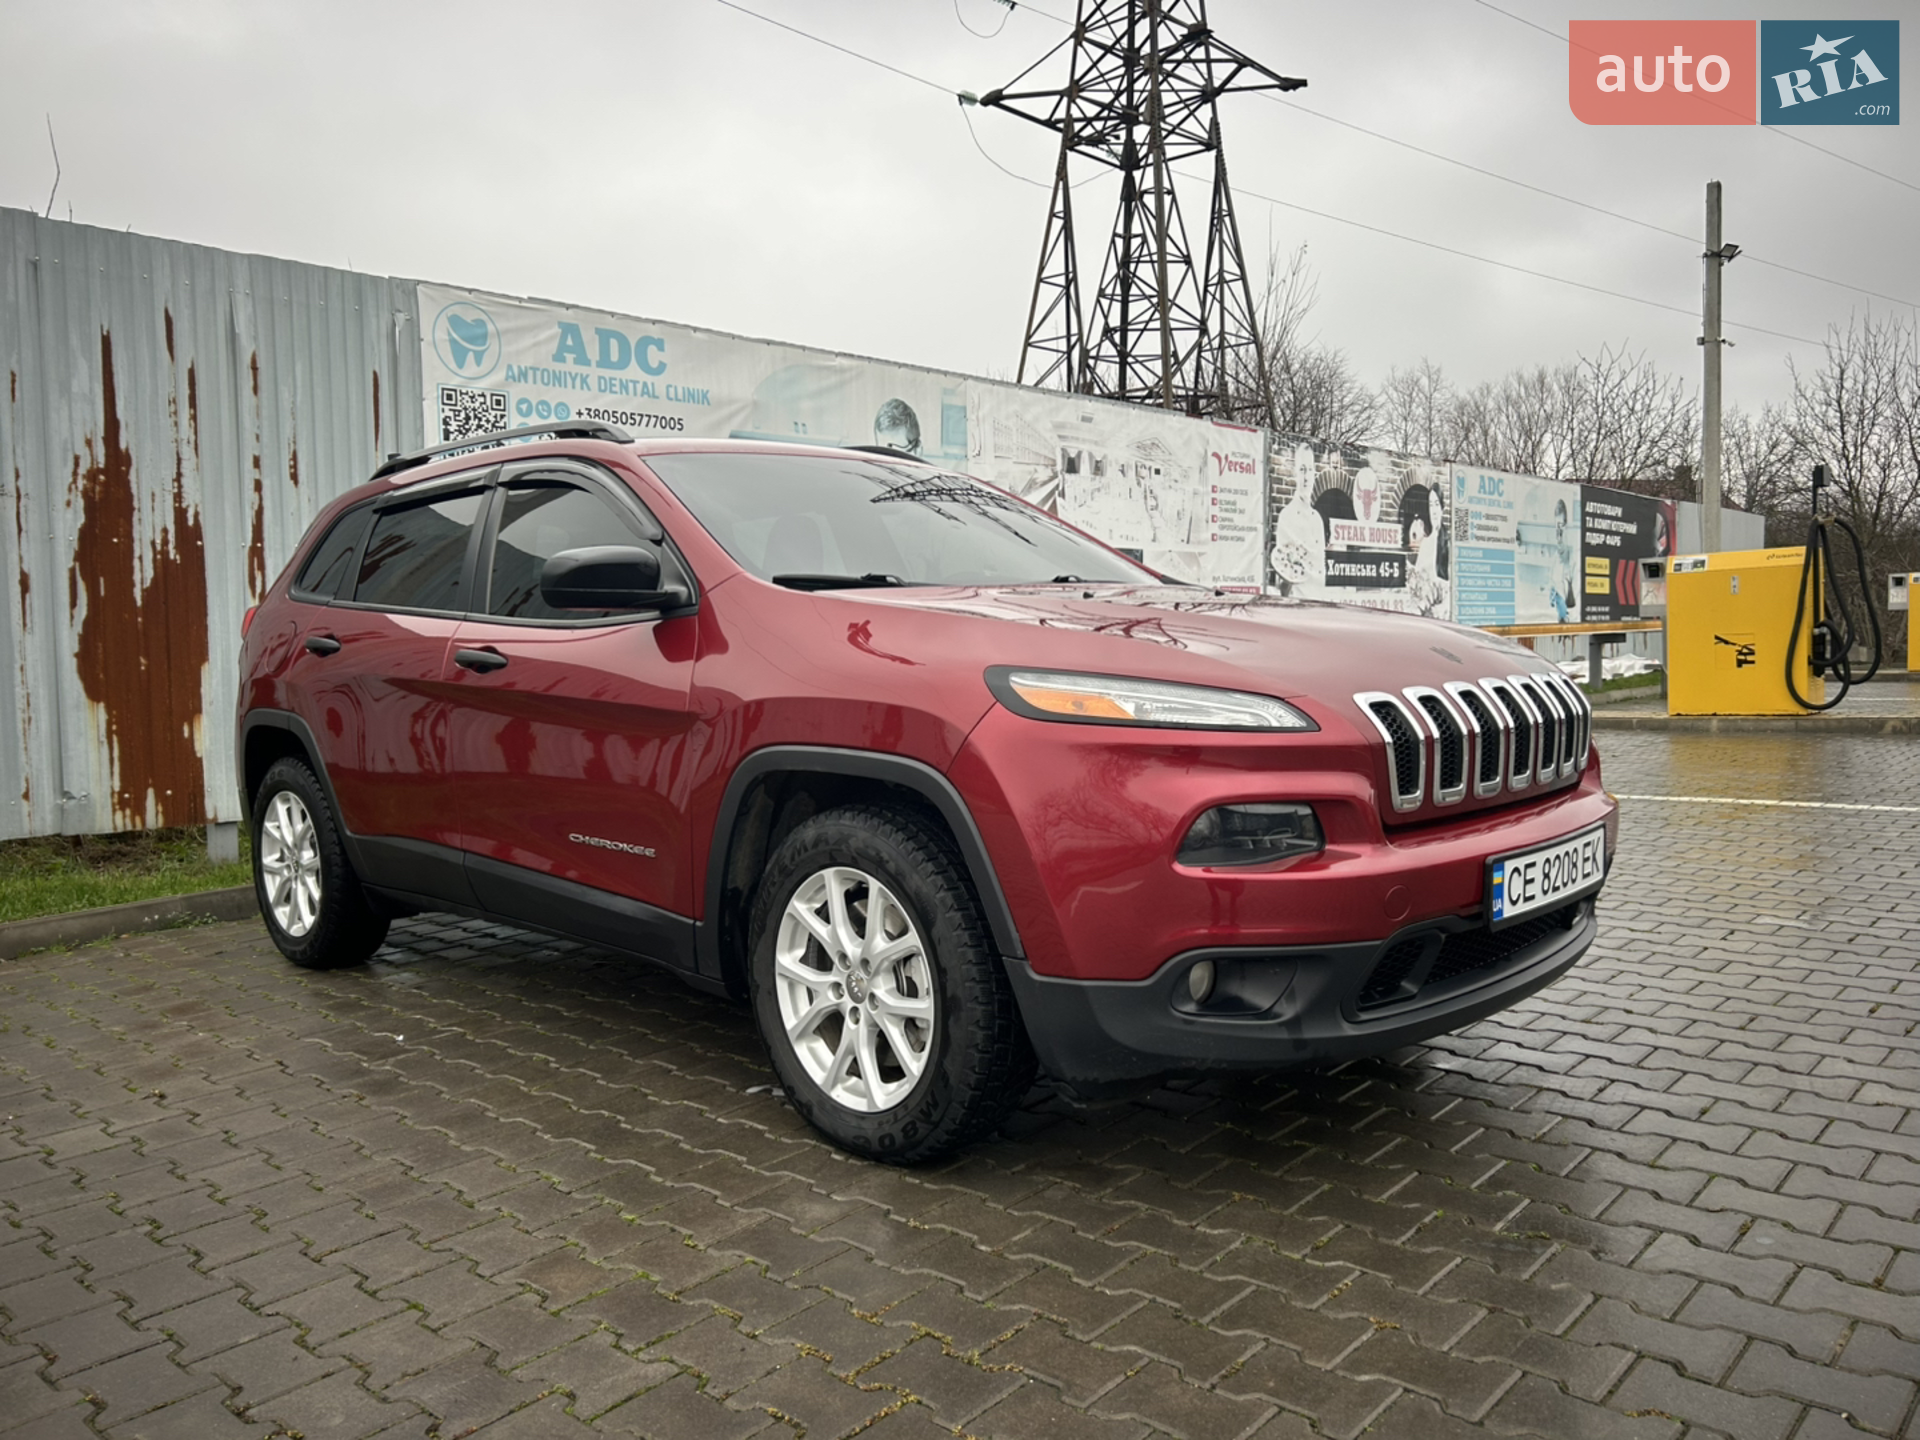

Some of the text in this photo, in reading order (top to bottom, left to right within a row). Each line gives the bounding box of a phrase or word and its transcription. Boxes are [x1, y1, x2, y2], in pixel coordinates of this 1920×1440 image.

[552, 321, 668, 377] ADC
[505, 364, 712, 406] ANTONIYK DENTAL CLINIK
[576, 408, 684, 432] +380505777005
[1211, 451, 1256, 476] Versal
[1478, 475, 1504, 497] ADC
[1585, 501, 1623, 518] АВТОТОВАРИ
[1585, 516, 1593, 528] ТА
[1334, 524, 1399, 544] STEAK HOUSE
[1606, 534, 1622, 547] ФАРБ
[1379, 562, 1400, 578] 45-Б
[568, 832, 656, 858] CHEROKEE
[1507, 837, 1601, 907] CE 8208 EK
[1493, 899, 1502, 912] UA
